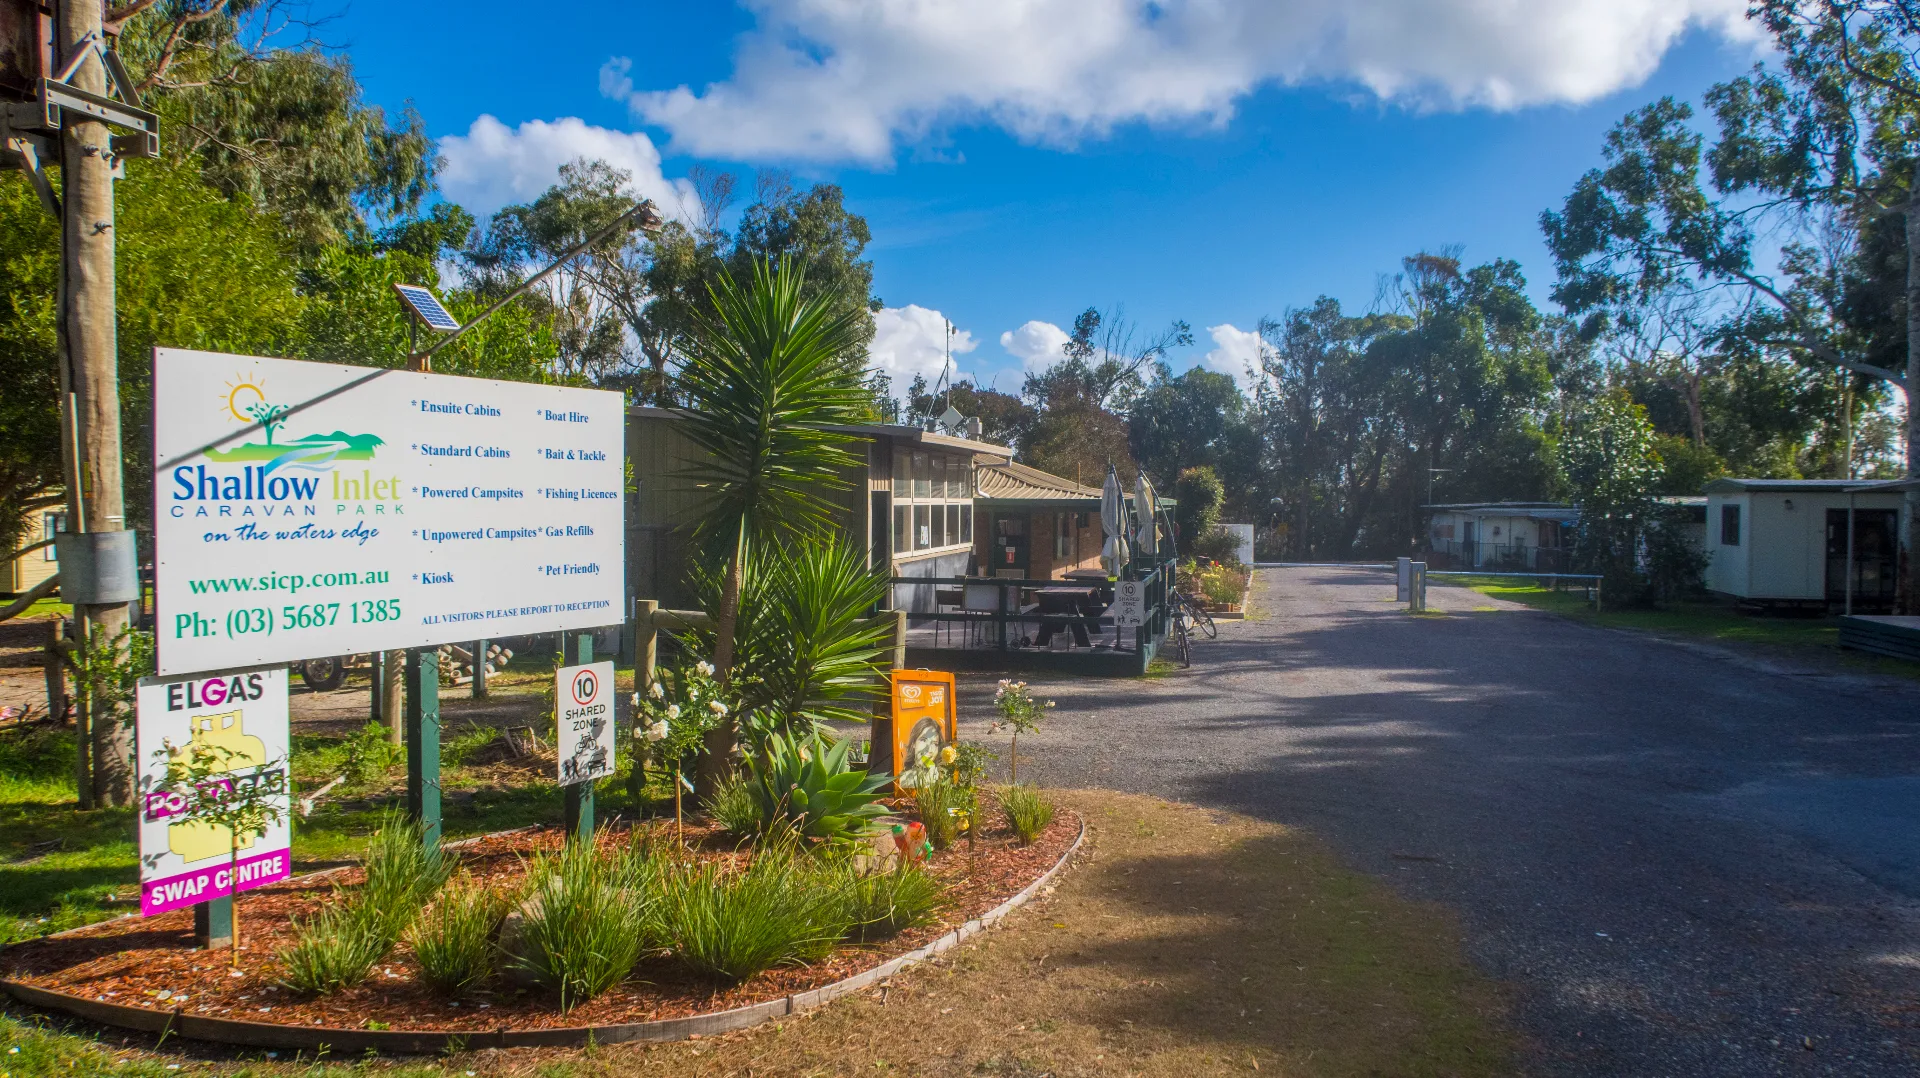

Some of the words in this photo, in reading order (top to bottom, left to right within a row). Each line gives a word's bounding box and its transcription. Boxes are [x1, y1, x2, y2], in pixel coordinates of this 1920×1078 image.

[421, 400, 462, 414] Ensuite
[465, 404, 500, 416] Cabins
[545, 410, 566, 421] Boat
[569, 412, 588, 423] Hire
[421, 444, 471, 456] Standard
[474, 446, 510, 458] Cabins
[546, 449, 564, 459] Bait
[567, 450, 575, 460] &
[578, 450, 605, 461] Tackle
[173, 465, 320, 501] Shallow
[332, 469, 402, 501] Inlet
[422, 487, 468, 498] Powered
[472, 487, 523, 501] Campsites
[546, 488, 578, 501] Fishing
[582, 489, 617, 498] Licences
[170, 505, 315, 517] CARAVAN
[337, 504, 404, 515] PARK
[203, 532, 230, 542] on
[235, 521, 270, 541] the
[275, 523, 336, 540] waters
[341, 521, 379, 546] edge
[422, 528, 483, 543] Unpowered
[486, 527, 536, 541] Campsites
[546, 527, 563, 536] Gas
[566, 526, 593, 536] Refills
[546, 566, 560, 575] Pet
[564, 563, 599, 575] Friendly
[189, 571, 388, 594] www.sicp.com.au
[422, 572, 454, 584] Kiosk
[1124, 586, 1133, 594] 10
[176, 612, 216, 638] Ph:
[226, 608, 273, 639] (03)
[283, 603, 340, 630] 5687
[350, 599, 402, 624] 1385
[422, 616, 440, 624] ALL
[442, 612, 484, 622] VISITORS
[486, 608, 518, 618] PLEASE
[520, 605, 552, 615] REPORT
[554, 604, 566, 613] TO
[567, 600, 610, 611] RECEPTION
[167, 674, 263, 712] ELGAS
[577, 677, 594, 698] 10
[565, 704, 606, 720] SHARED
[573, 718, 598, 731] ZONE
[151, 875, 209, 906] SWAP
